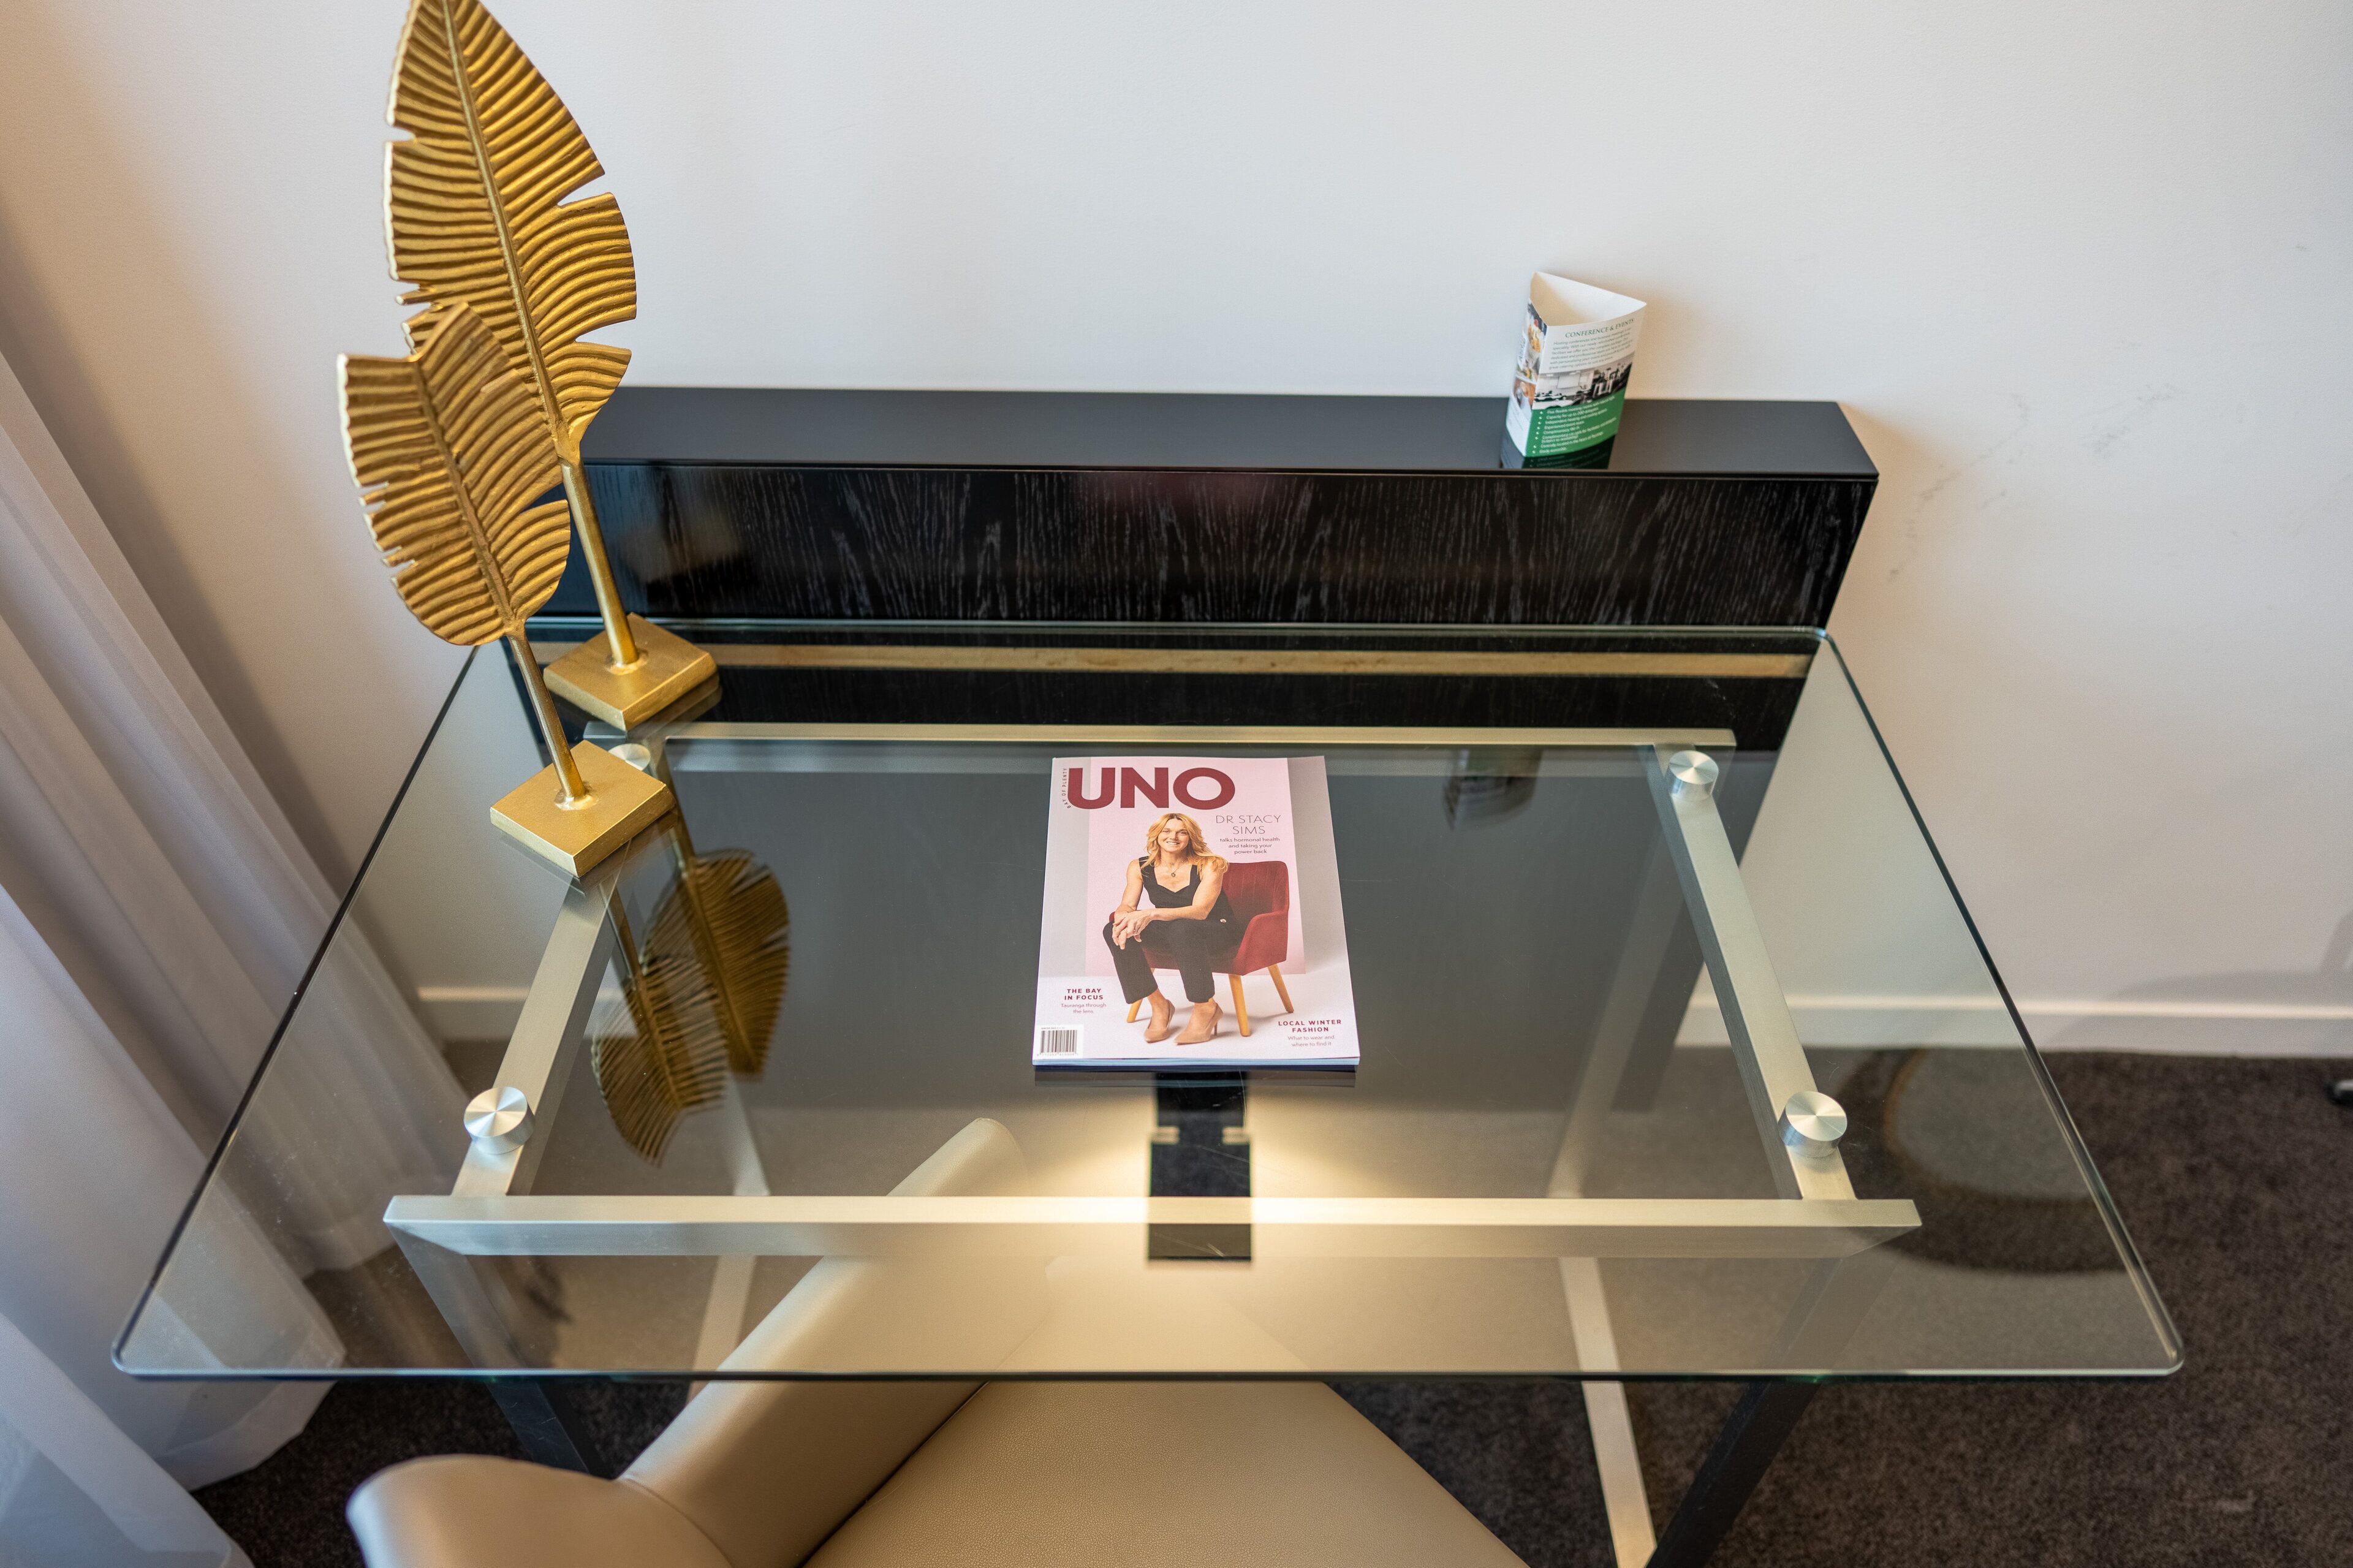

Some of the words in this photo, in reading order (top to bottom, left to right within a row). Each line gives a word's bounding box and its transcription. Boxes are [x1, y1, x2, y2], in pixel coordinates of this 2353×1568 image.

[1565, 328, 1608, 338] CONFERENCE
[1615, 318, 1634, 329] EVENTS
[1068, 767, 1235, 810] UNO
[1061, 799, 1072, 809] BAY
[1216, 815, 1234, 824] DR
[1238, 814, 1281, 824] STACY
[1232, 825, 1265, 835] SIMS
